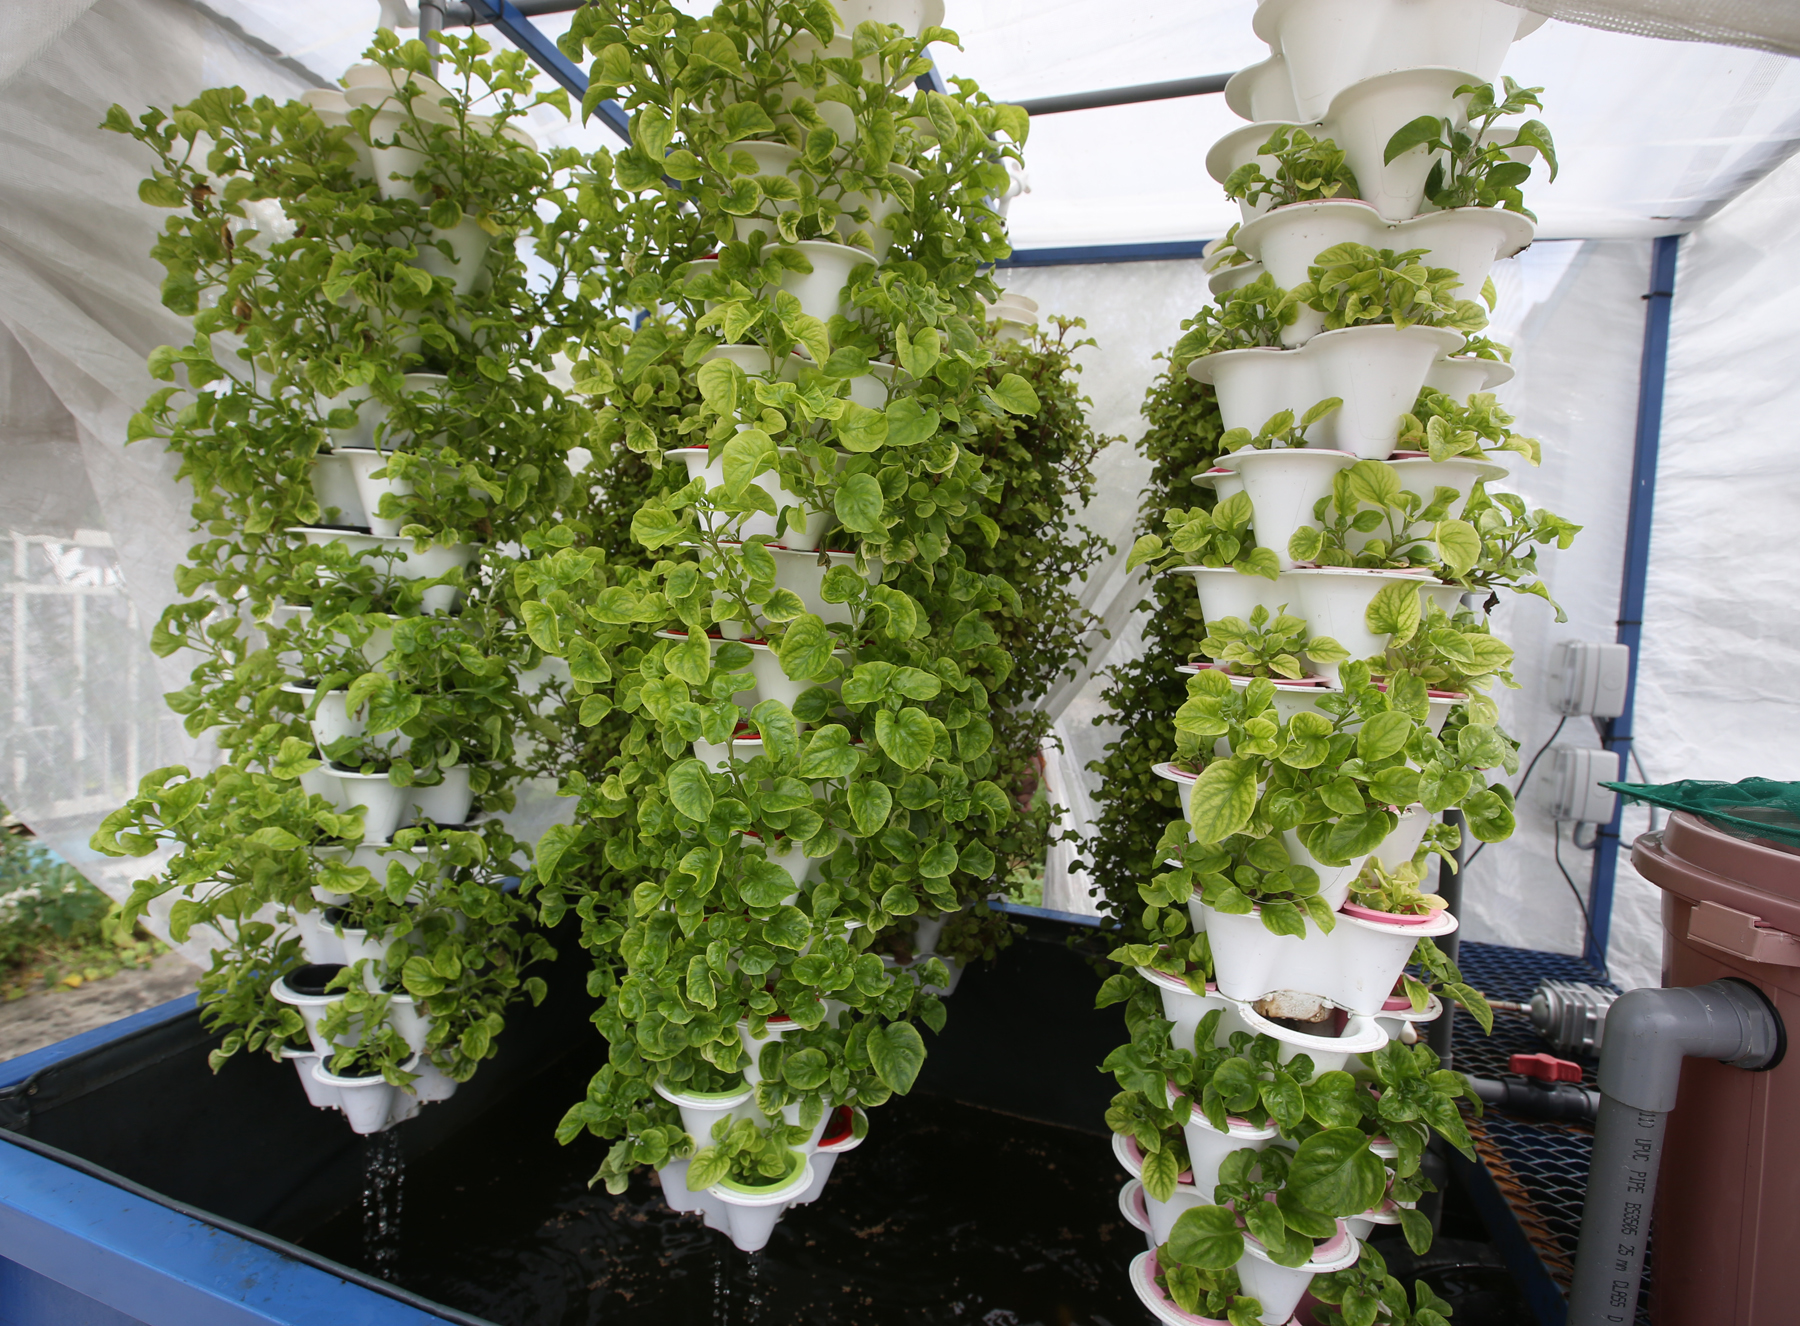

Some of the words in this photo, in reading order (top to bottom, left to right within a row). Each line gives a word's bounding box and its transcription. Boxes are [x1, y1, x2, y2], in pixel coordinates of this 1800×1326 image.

[1627, 1169, 1647, 1194] PIPE
[1621, 1202, 1642, 1236] BS3505
[1617, 1243, 1635, 1257] 25
[1610, 1280, 1629, 1308] CLASS
[1607, 1314, 1623, 1323] D
